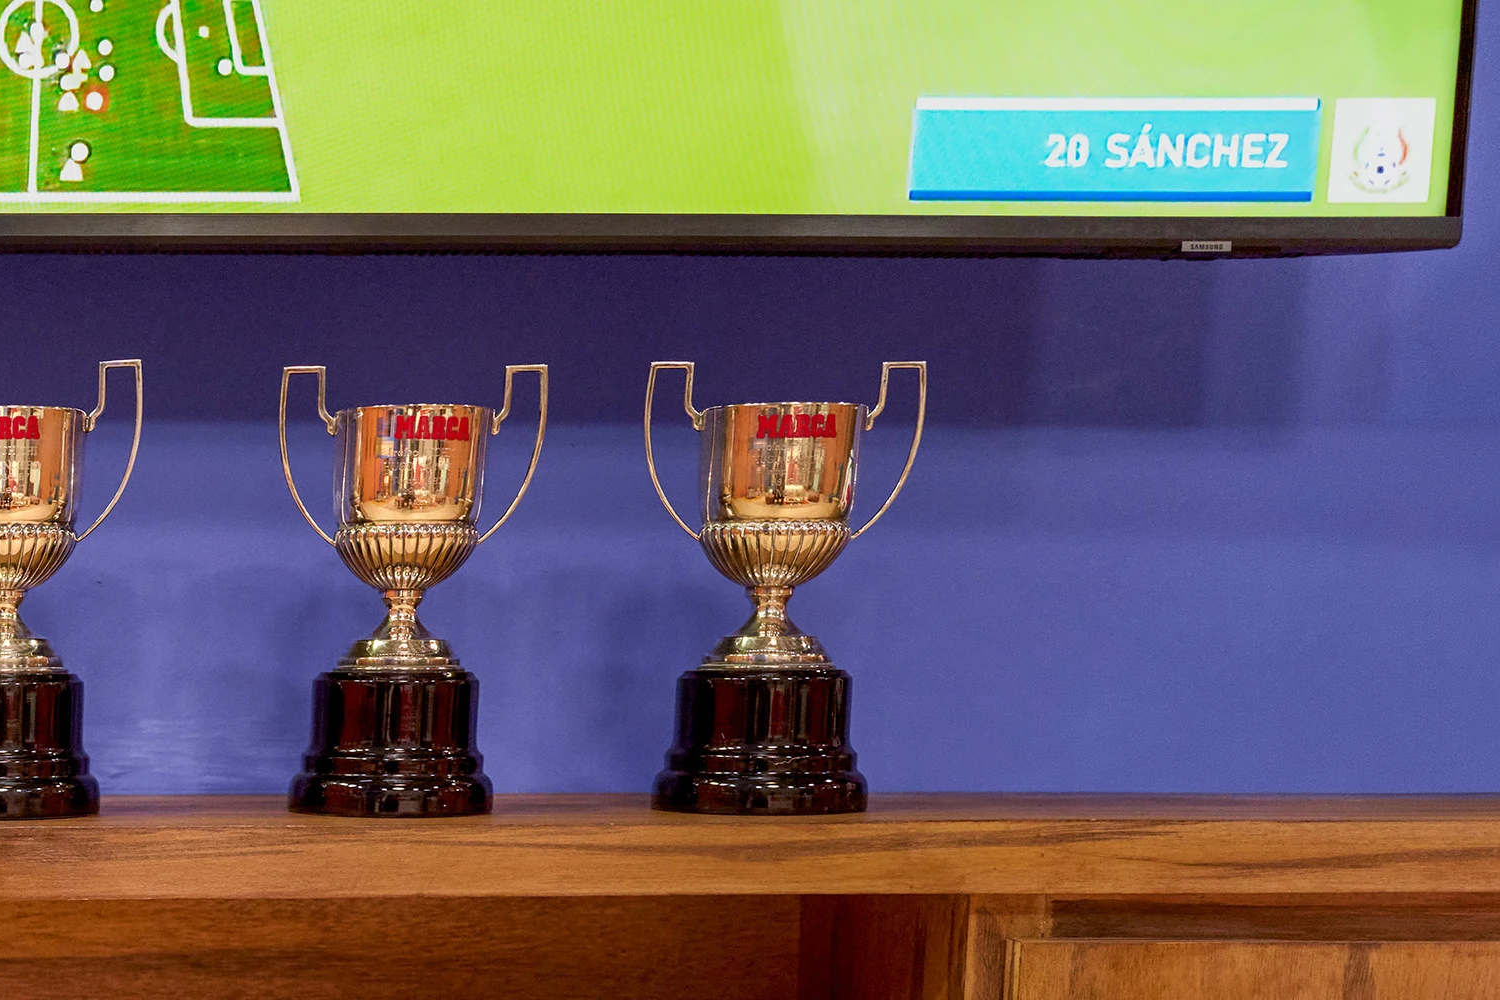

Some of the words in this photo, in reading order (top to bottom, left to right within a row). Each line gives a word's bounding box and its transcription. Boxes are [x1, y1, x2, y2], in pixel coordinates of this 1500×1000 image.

[1043, 132, 1091, 170] 20
[1104, 123, 1290, 170] SÁNCHEZ
[394, 415, 470, 441] MARCA
[756, 413, 837, 439] MARCA
